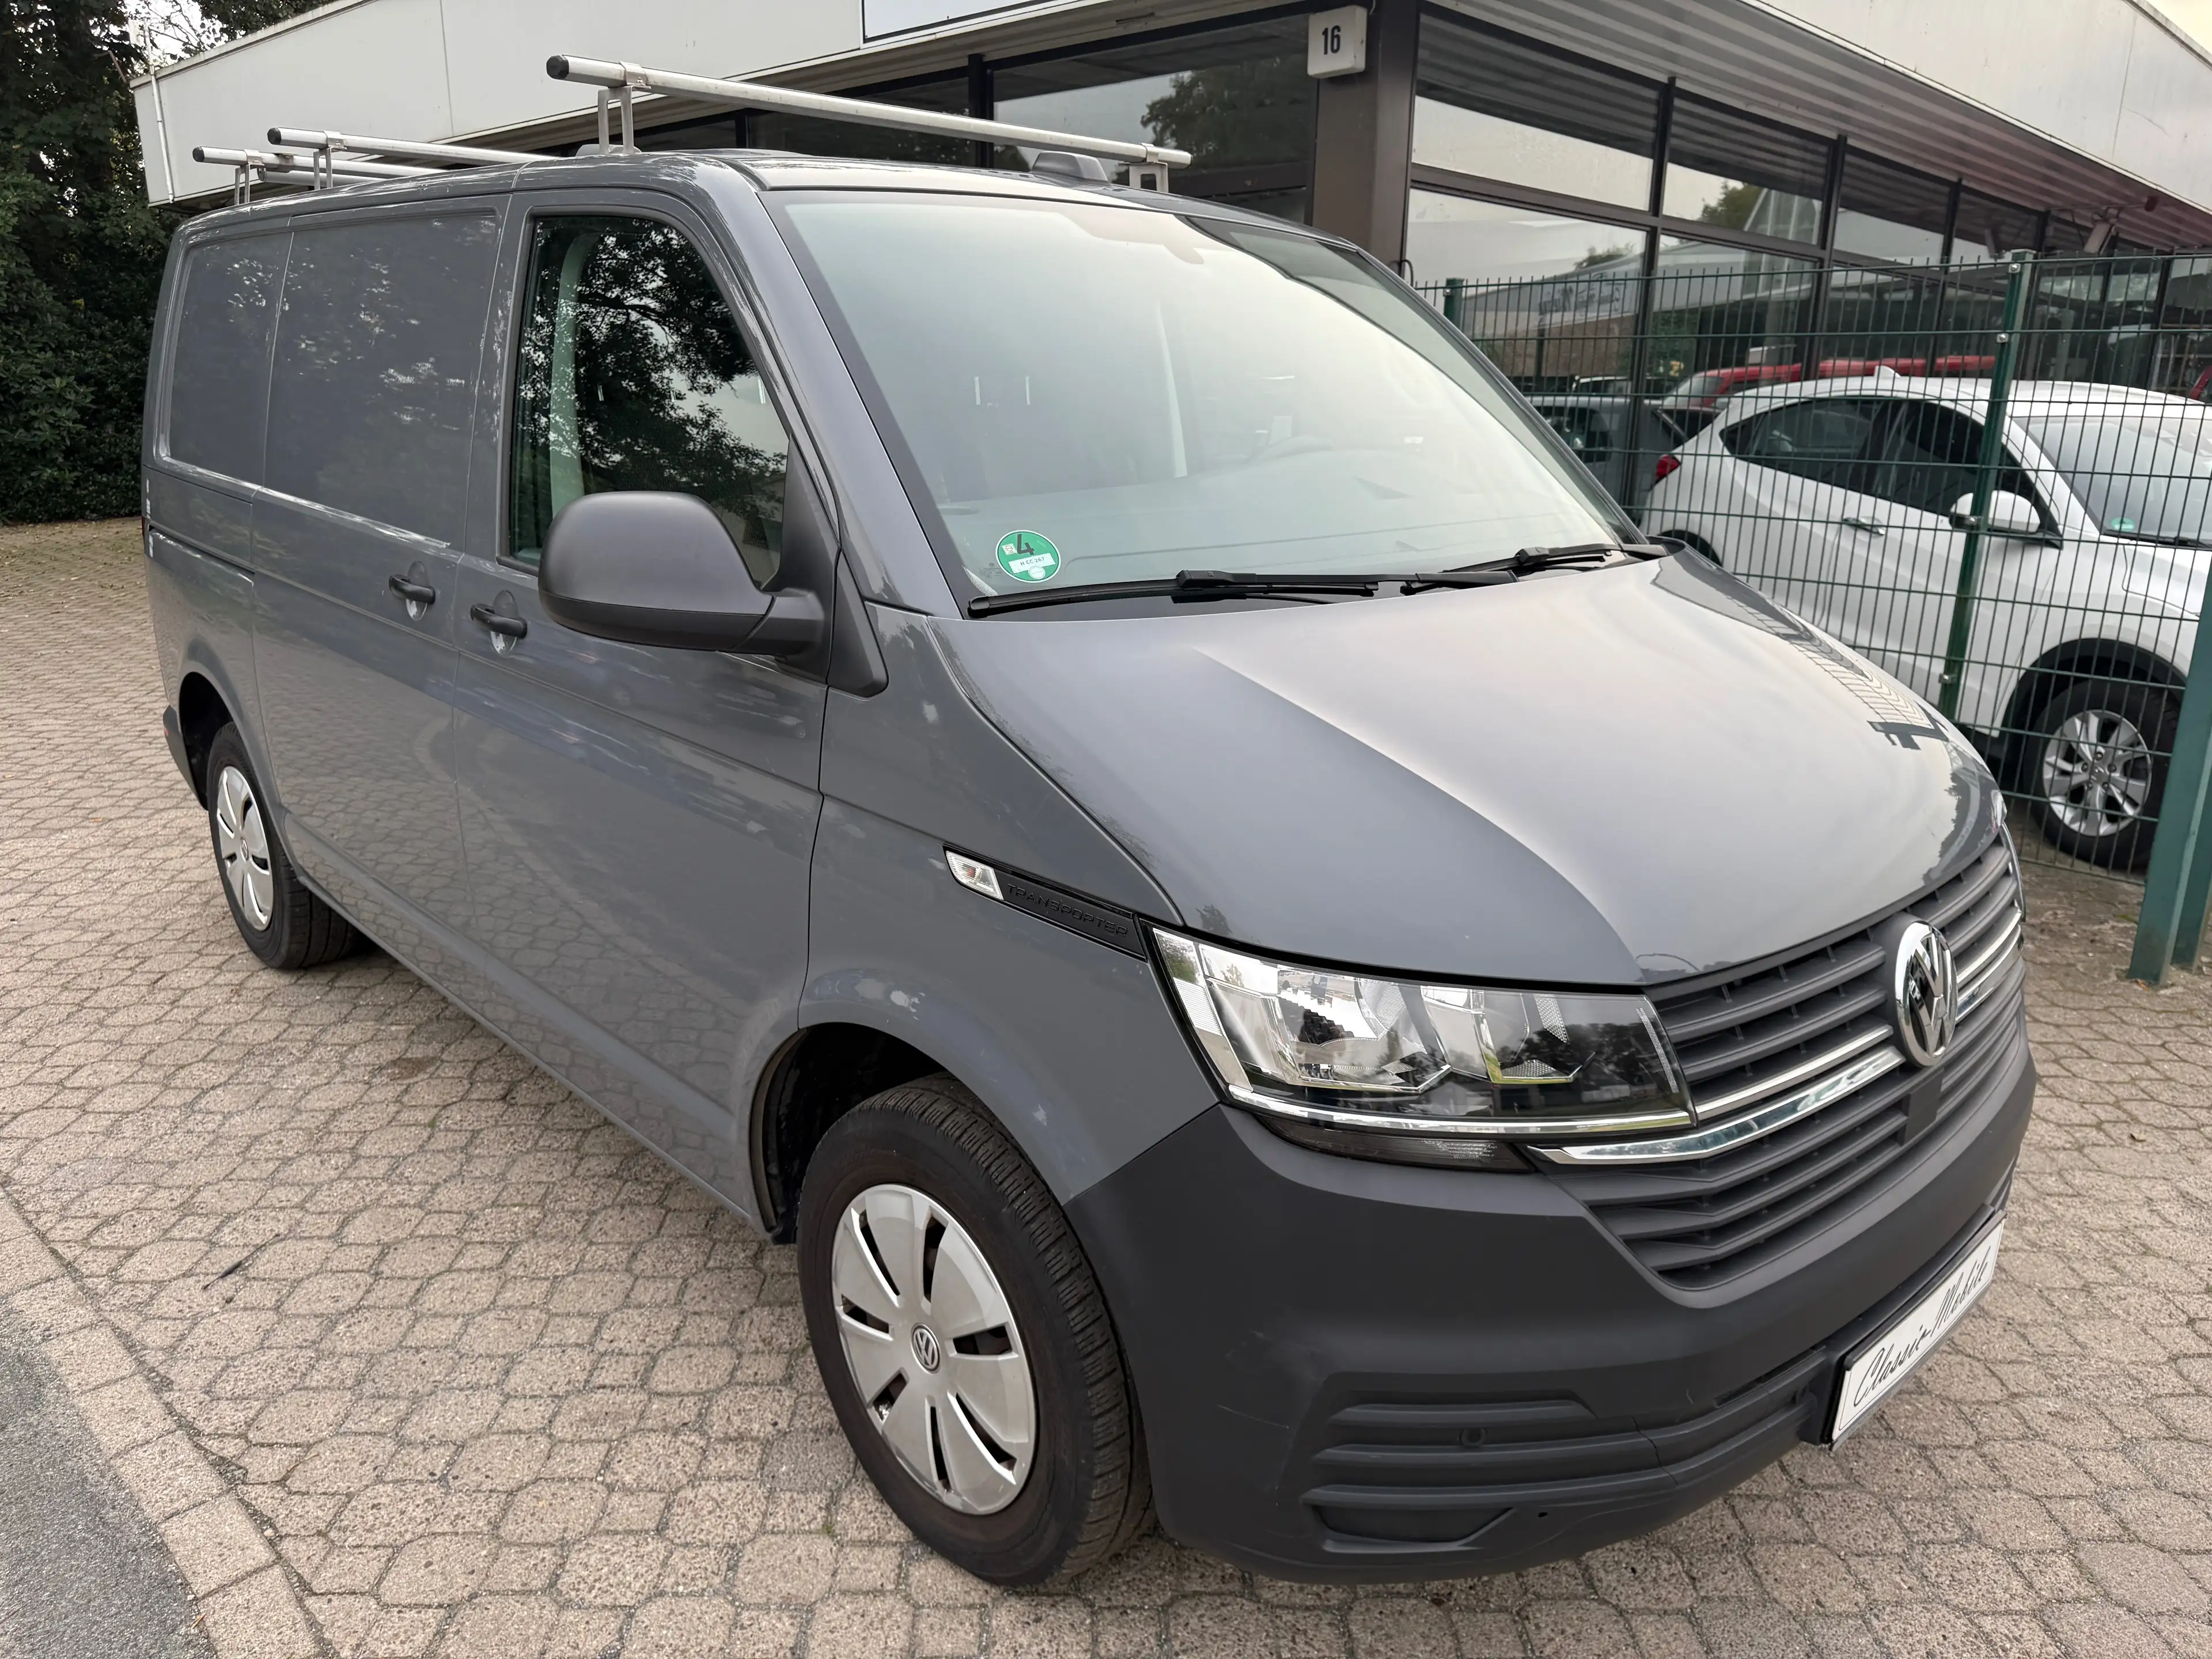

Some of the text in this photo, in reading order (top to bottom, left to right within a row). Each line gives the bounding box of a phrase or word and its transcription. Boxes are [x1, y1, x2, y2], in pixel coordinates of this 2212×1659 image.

[1322, 25, 1340, 55] 16
[1017, 533, 1035, 555] 4
[1007, 883, 1128, 938] TRANSPORTER
[1854, 1246, 1991, 1407] Classic Mobile
